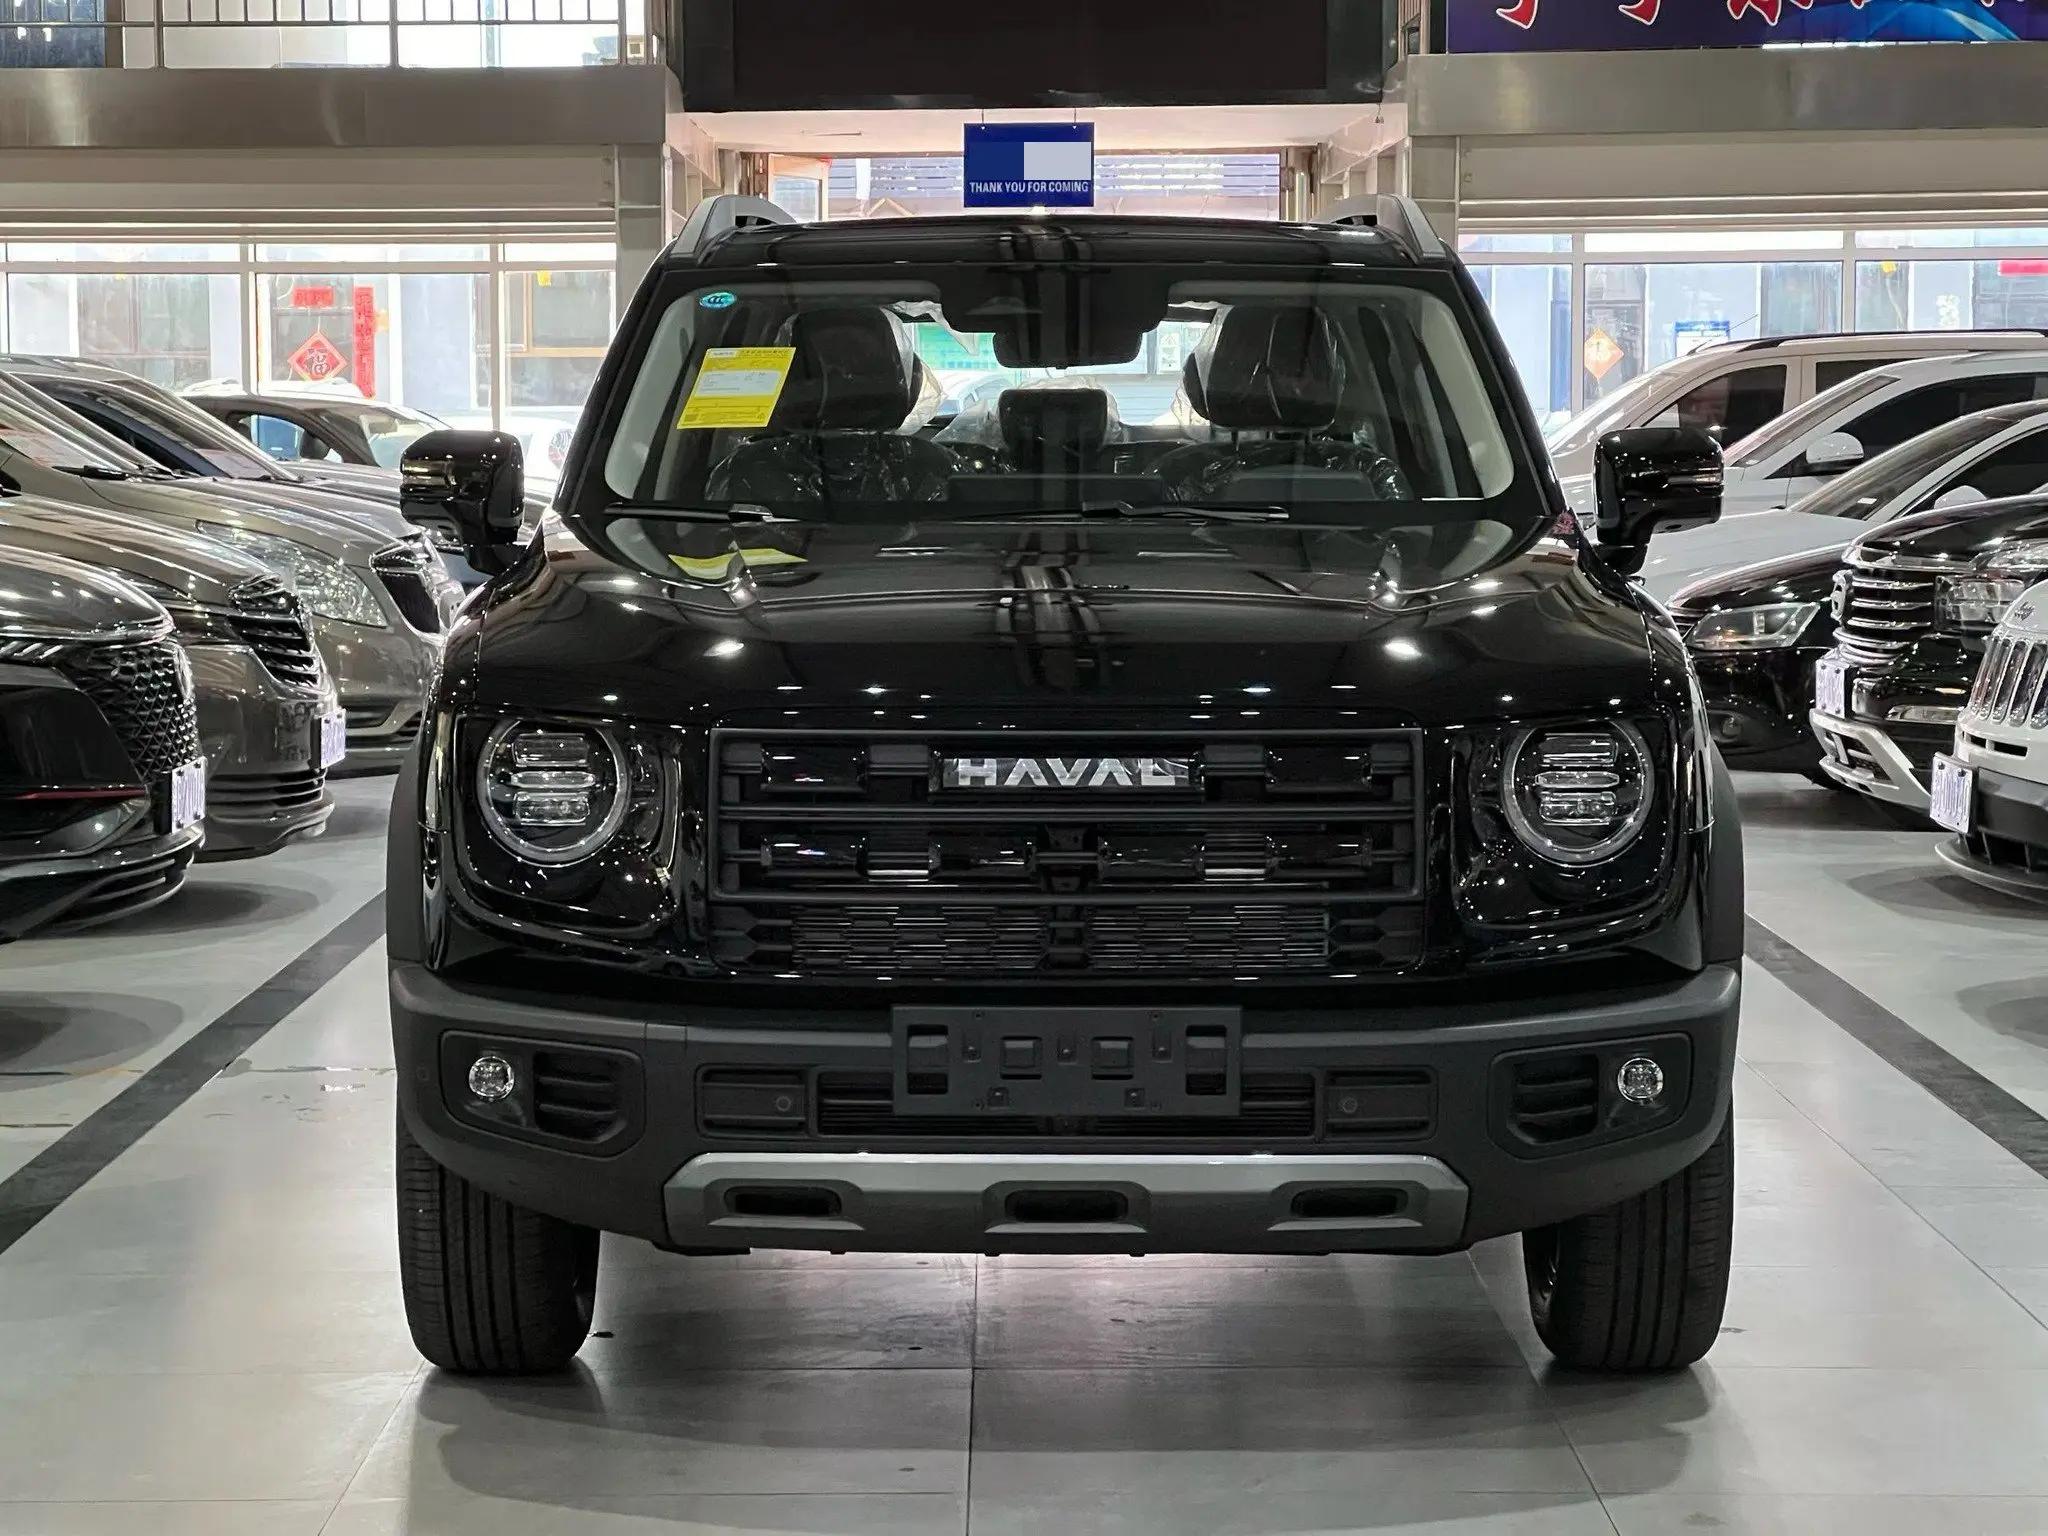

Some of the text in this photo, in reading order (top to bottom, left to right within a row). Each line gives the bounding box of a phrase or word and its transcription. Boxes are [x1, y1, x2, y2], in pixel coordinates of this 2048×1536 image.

[969, 181, 1089, 193] THANK YOU FOR COMING
[957, 757, 1176, 787] HAVAL
